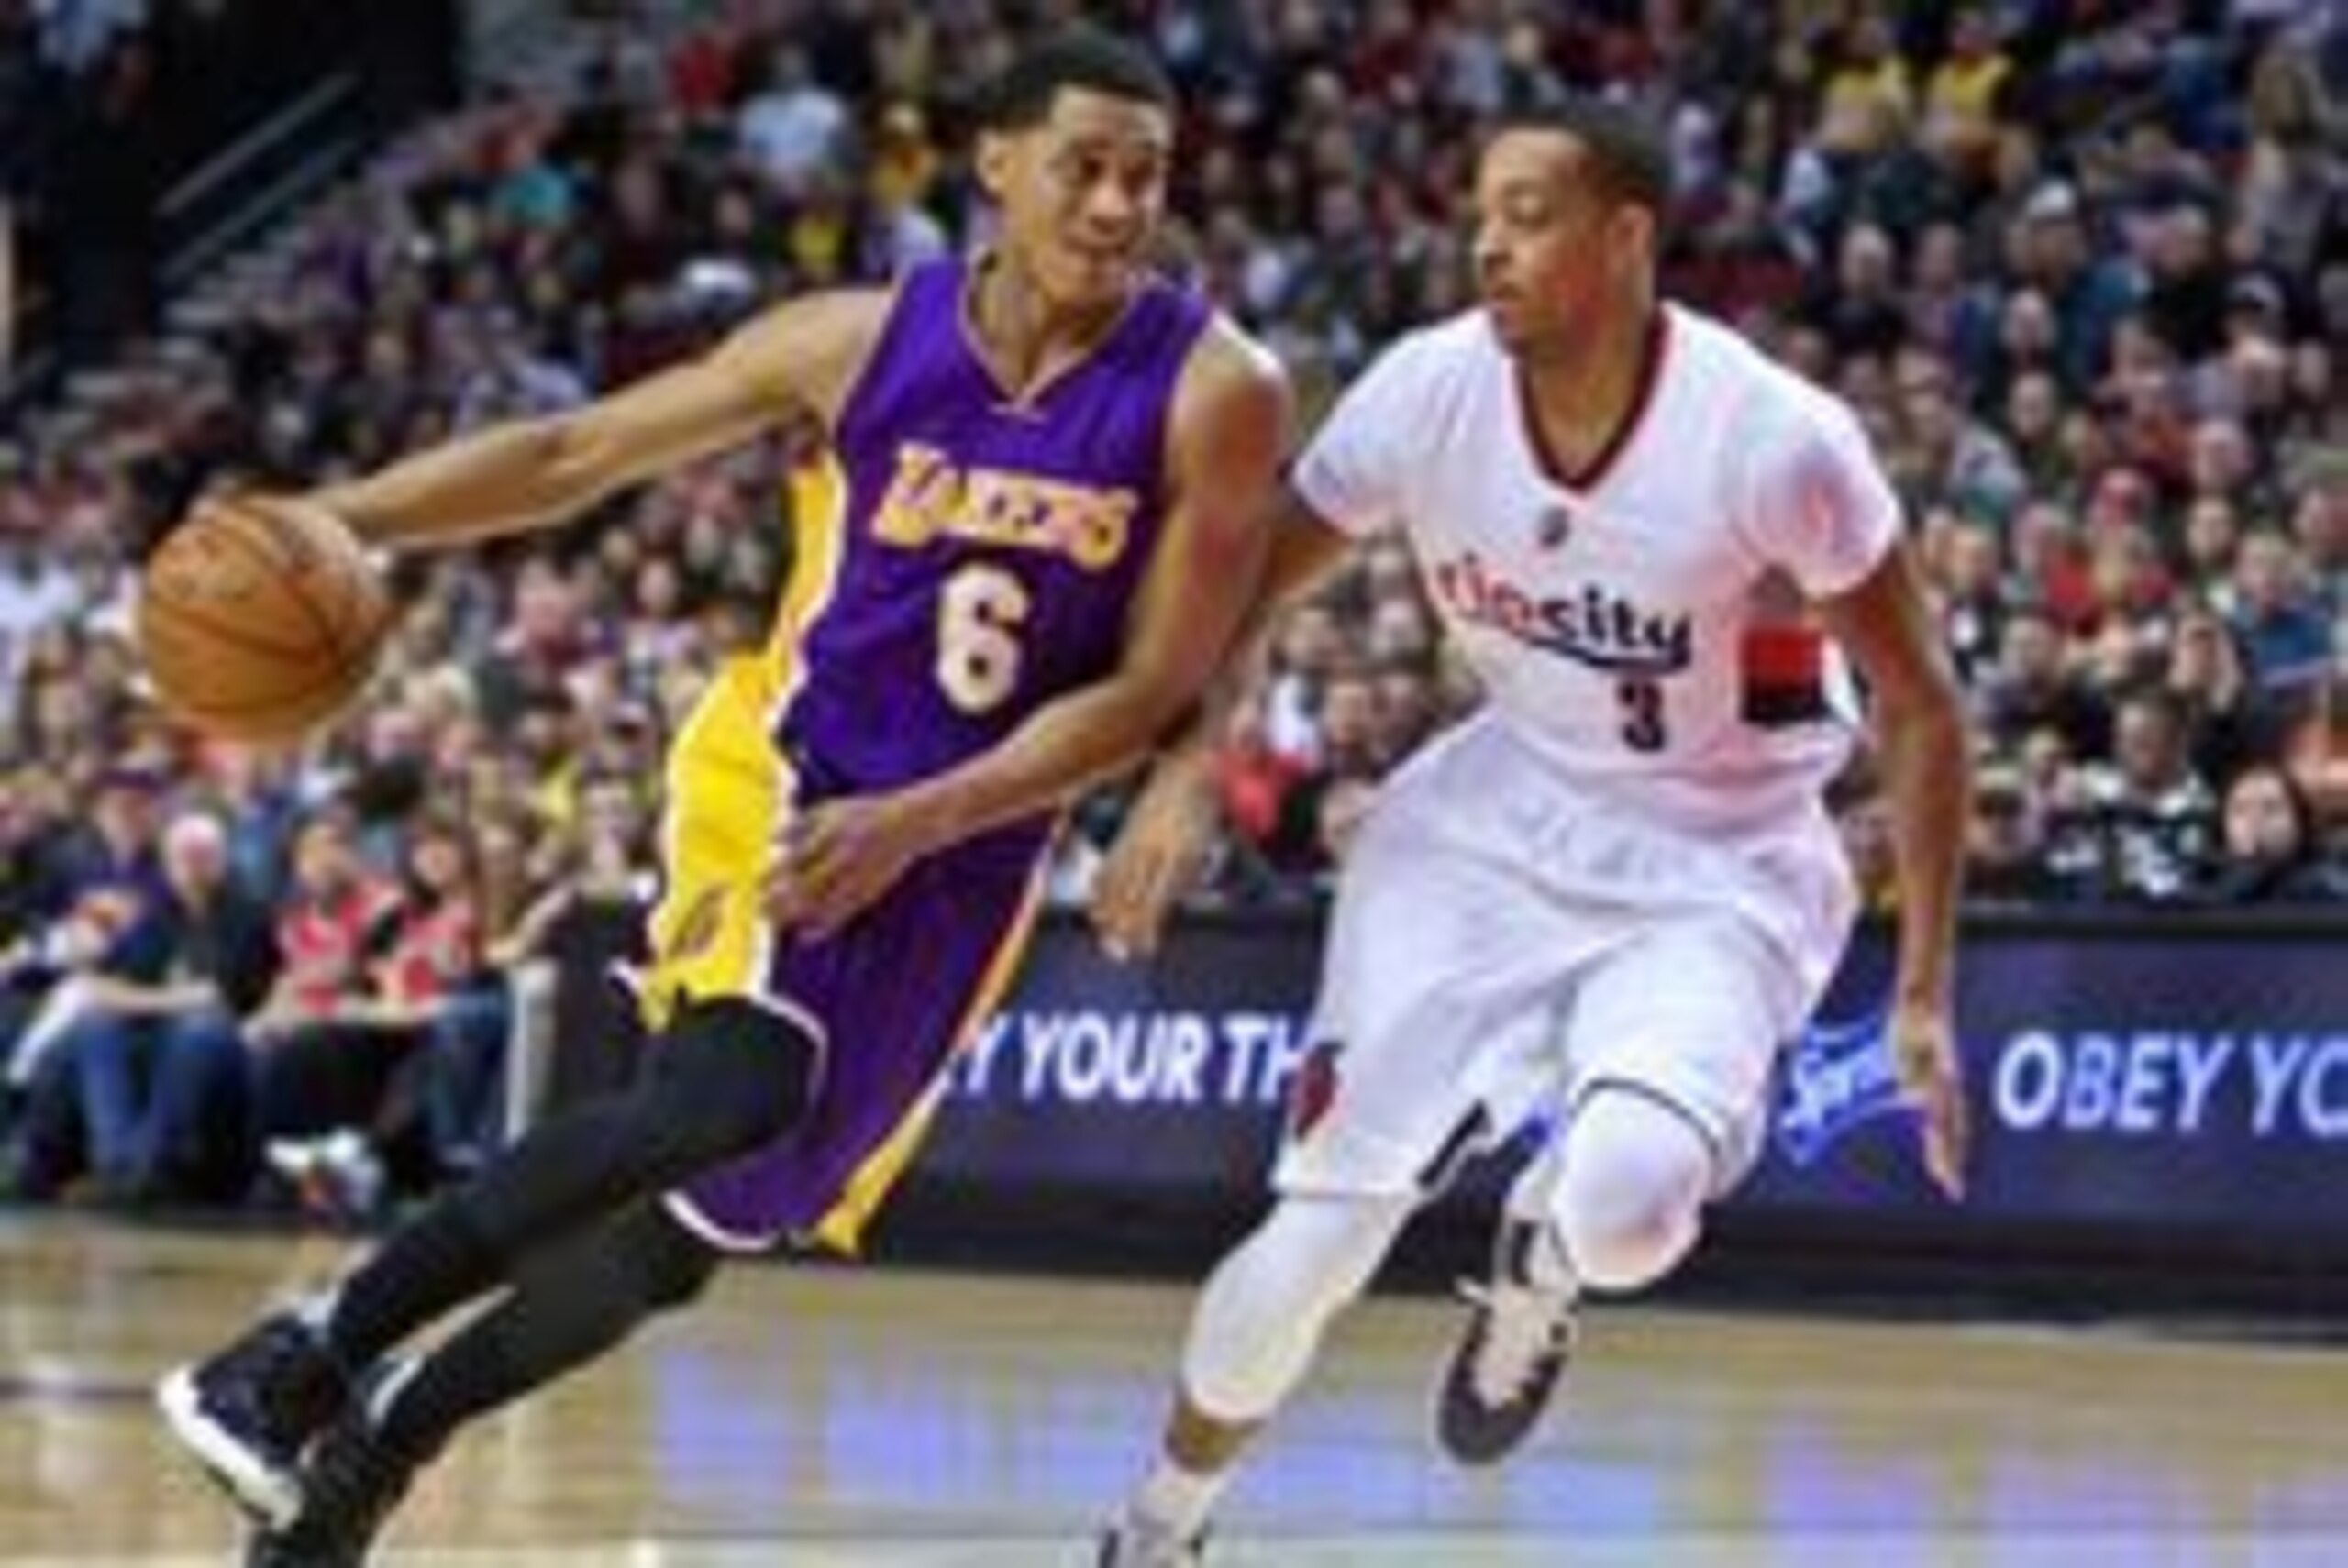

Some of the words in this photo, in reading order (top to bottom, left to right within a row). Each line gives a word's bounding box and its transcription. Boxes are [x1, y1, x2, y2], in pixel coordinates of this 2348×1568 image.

[869, 440, 1139, 572] LAKERS
[936, 563, 1031, 715] 6
[1618, 679, 1667, 754] 3
[1021, 1013, 1213, 1100] YOUR
[1996, 1031, 2231, 1133] OBEY
